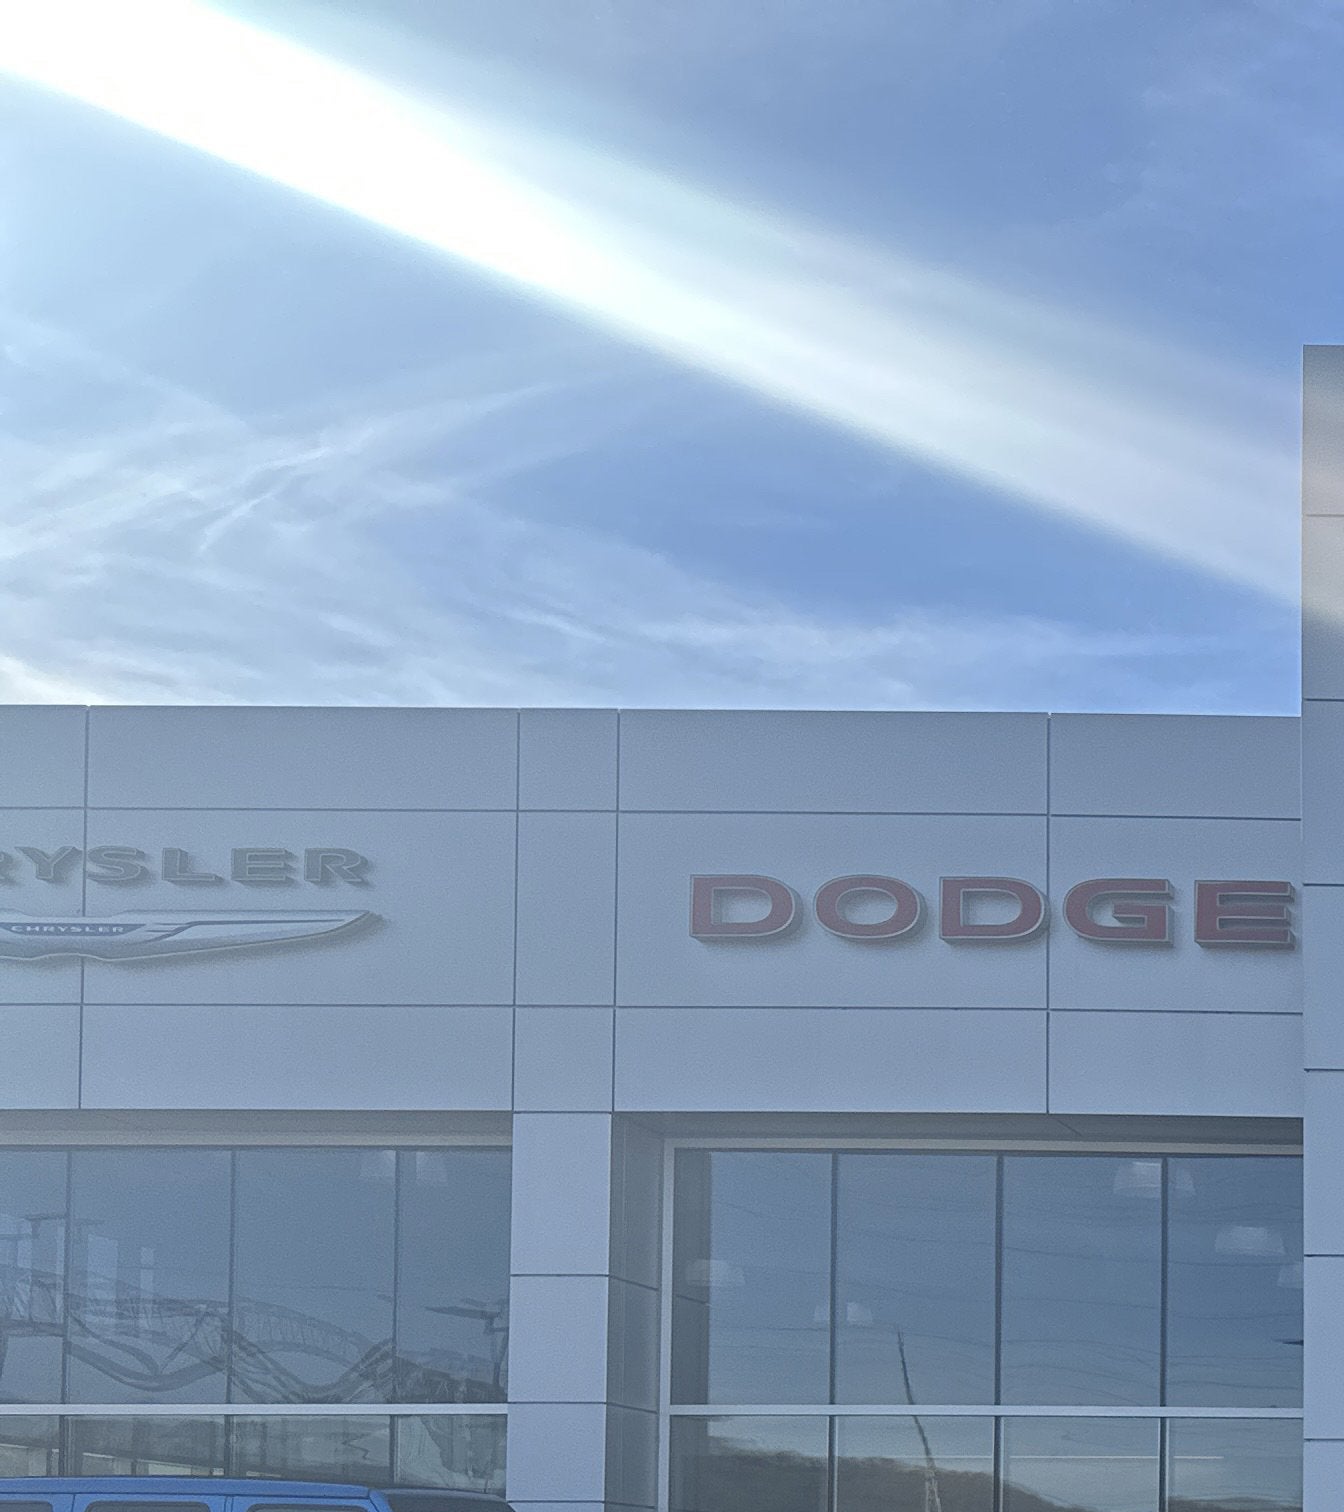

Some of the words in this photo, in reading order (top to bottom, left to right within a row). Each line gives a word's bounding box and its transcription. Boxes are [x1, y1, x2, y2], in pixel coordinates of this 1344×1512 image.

[0, 845, 371, 885] YSLER
[10, 924, 124, 934] CHRYSLER
[689, 873, 1296, 949] DODGE
